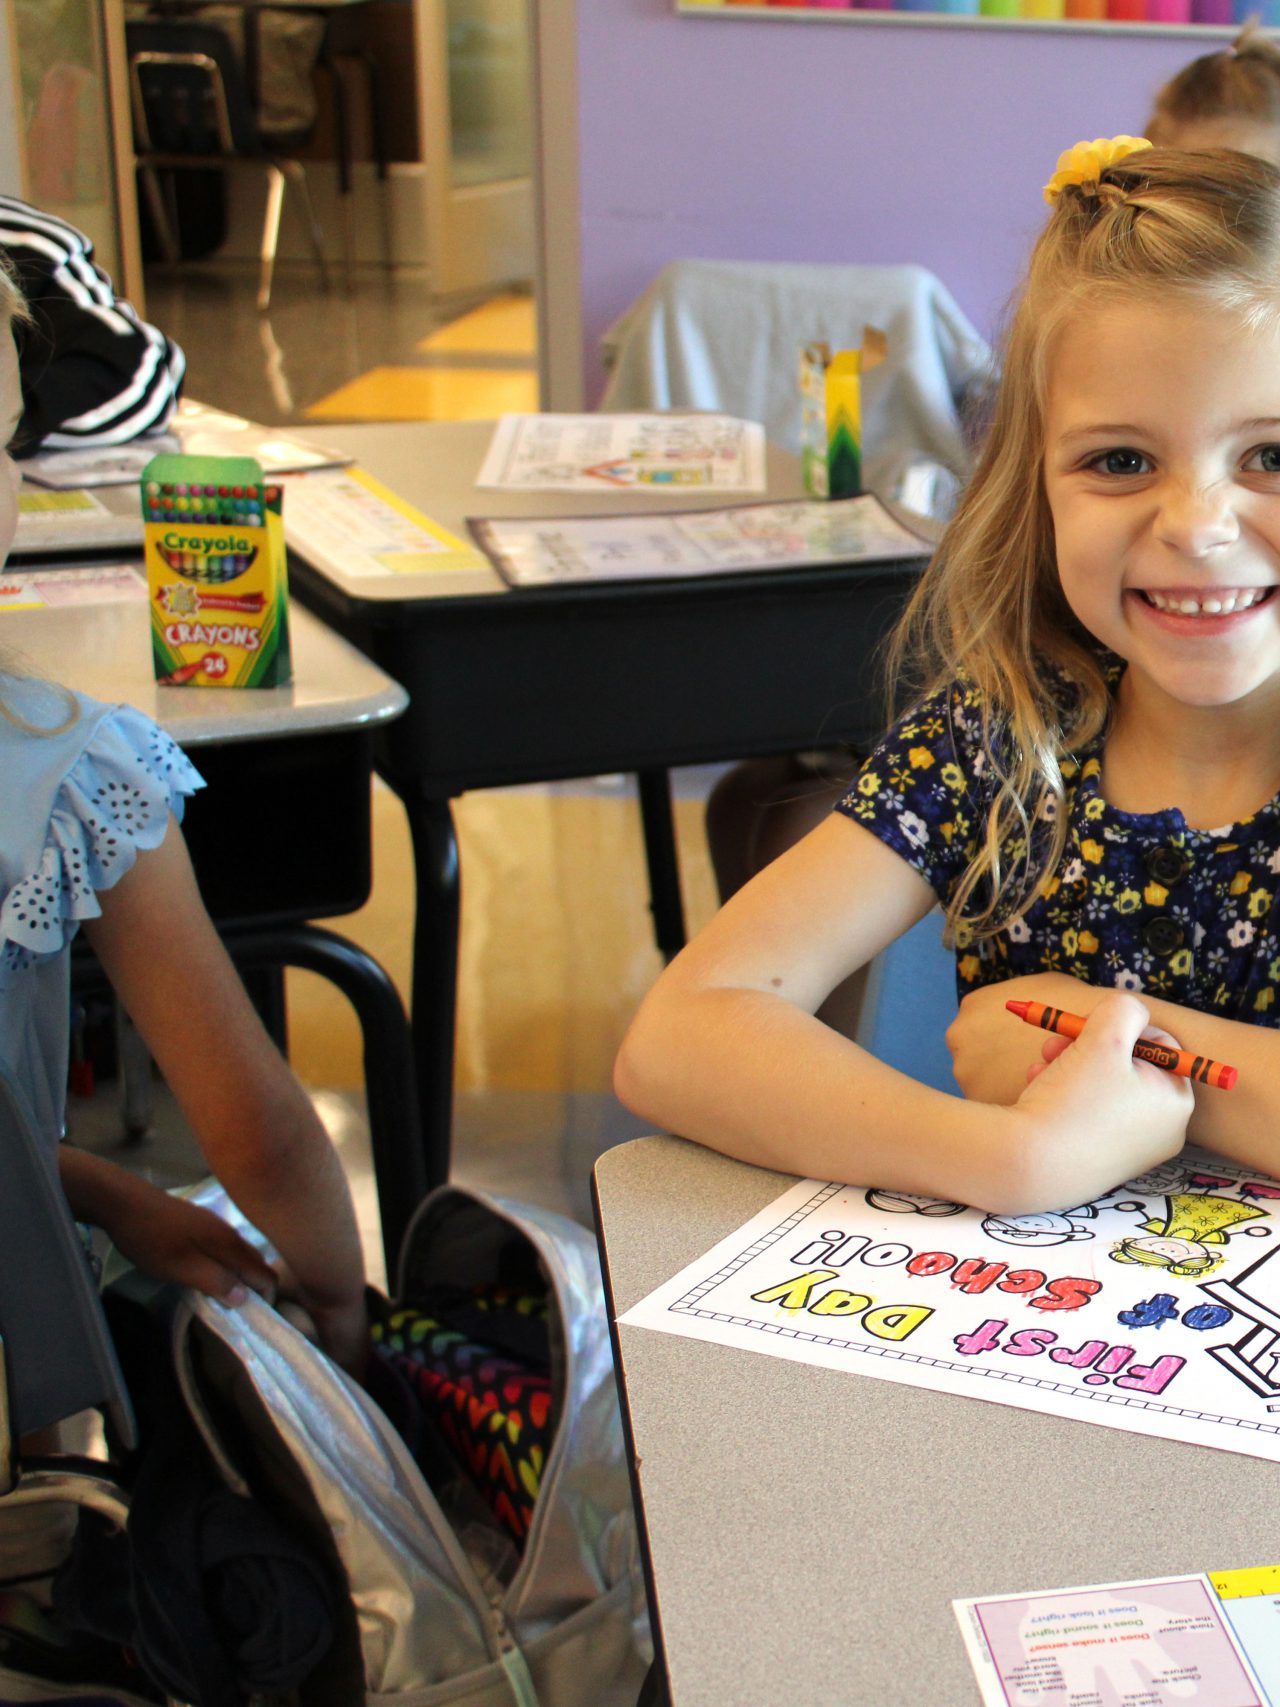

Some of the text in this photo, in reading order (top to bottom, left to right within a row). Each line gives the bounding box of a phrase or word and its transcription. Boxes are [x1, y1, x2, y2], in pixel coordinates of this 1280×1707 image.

[163, 532, 251, 555] Crayola
[165, 623, 260, 650] CRAYONS
[204, 656, 226, 673] 24
[1134, 1045, 1170, 1065] yola
[790, 1230, 1234, 1332] of School!
[749, 1269, 1187, 1396] First Day
[1068, 1610, 1094, 1618] look
[1108, 1606, 1138, 1614] Does
[1030, 1614, 1066, 1624] right?
[1114, 1619, 1144, 1627] Does
[1168, 1617, 1192, 1626] story.
[1024, 1628, 1060, 1638] right?
[1063, 1624, 1099, 1634] sound
[1158, 1626, 1187, 1634] about
[1120, 1632, 1150, 1641] Does
[1029, 1642, 1068, 1652] sense?
[1072, 1638, 1105, 1646] make
